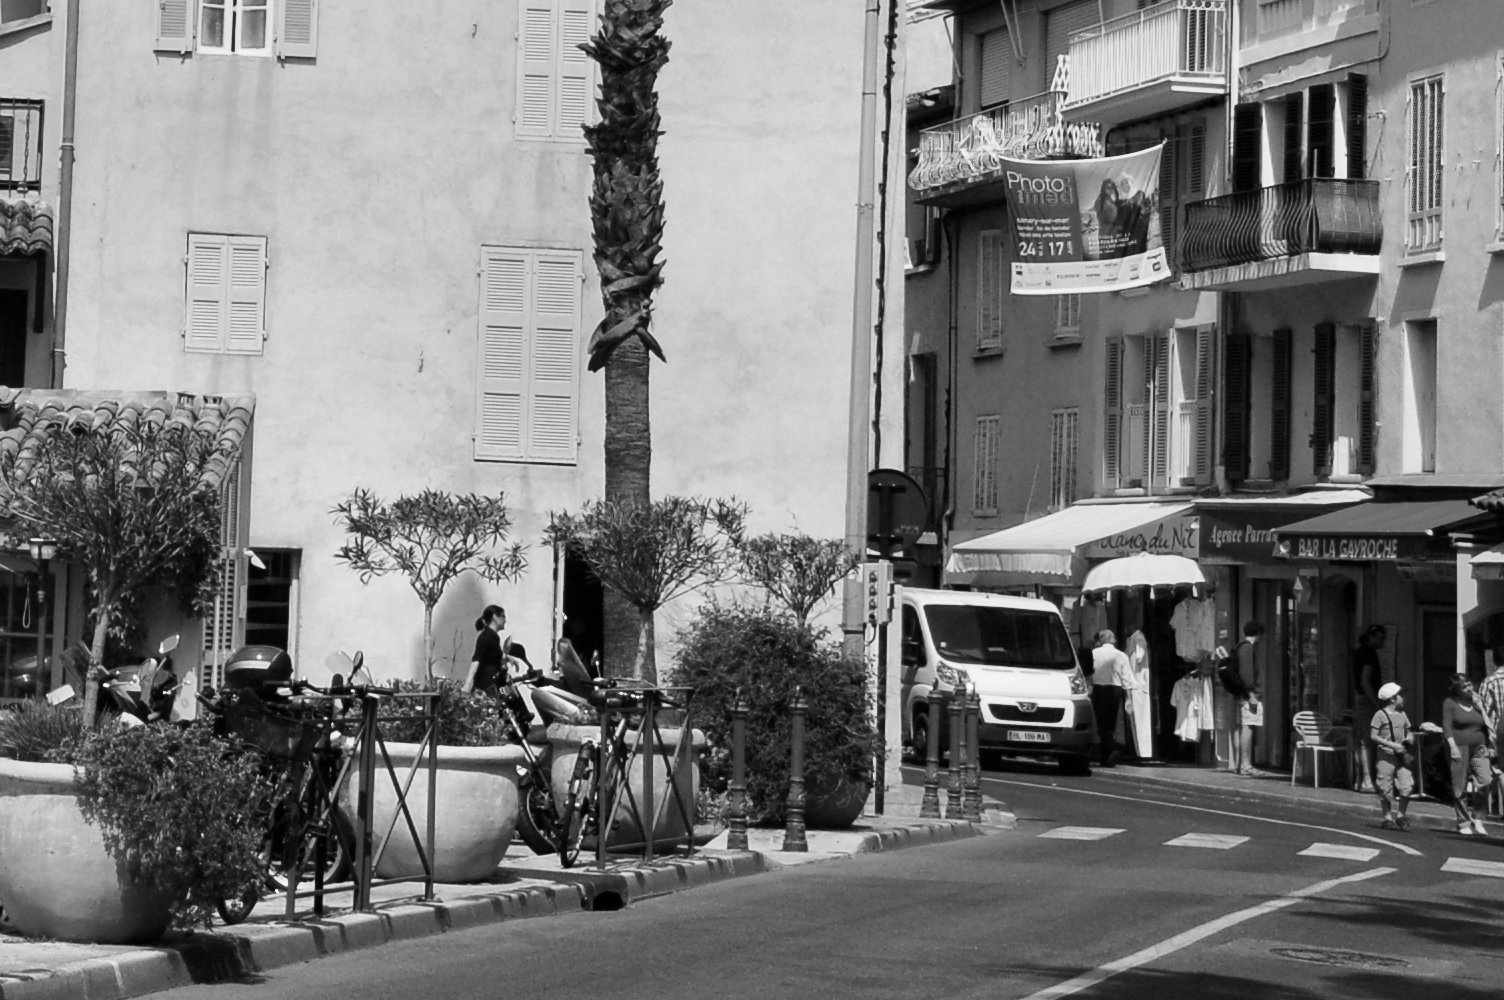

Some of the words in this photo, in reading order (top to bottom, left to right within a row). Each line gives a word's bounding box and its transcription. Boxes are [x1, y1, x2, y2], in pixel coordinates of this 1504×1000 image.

[1007, 170, 1064, 193] Photo
[1019, 241, 1036, 256] 24
[1048, 241, 1064, 256] 17
[1148, 522, 1169, 550] du
[1209, 524, 1243, 548] Agence
[1298, 538, 1319, 557] BAR
[1322, 539, 1336, 558] LA
[1339, 539, 1398, 559] GAVROCHE
